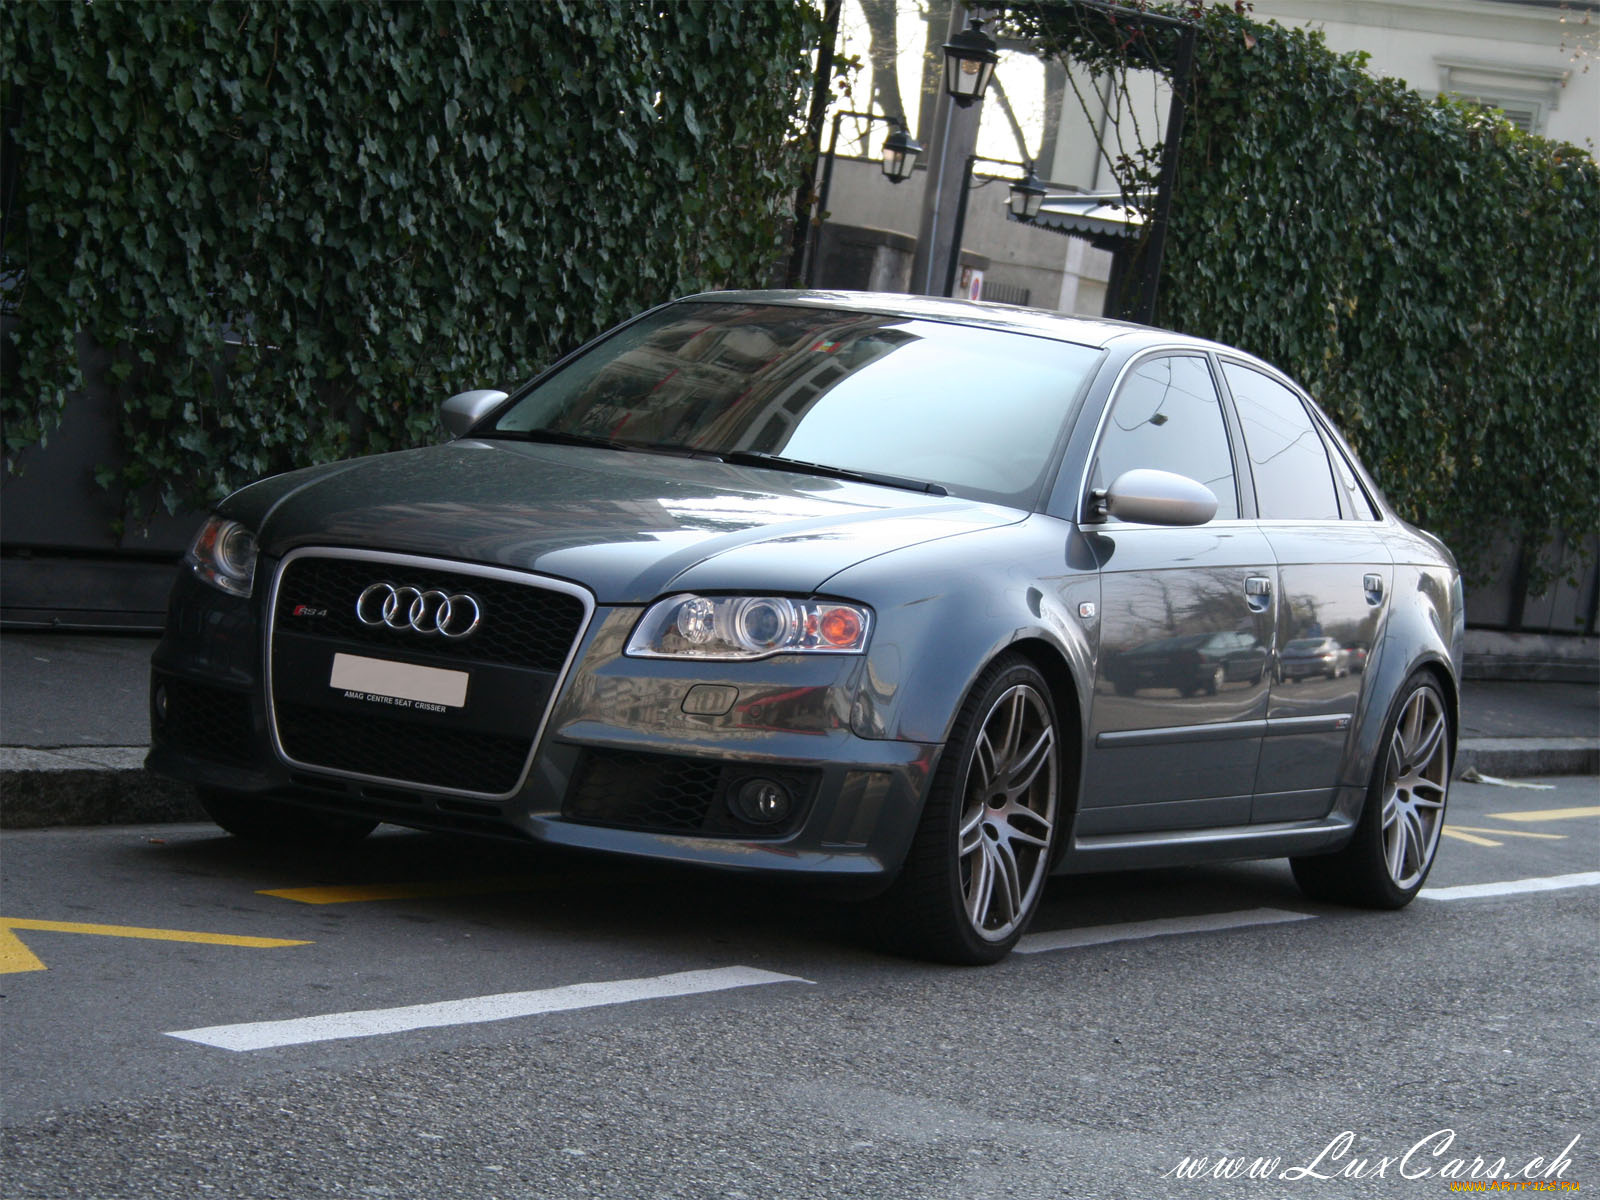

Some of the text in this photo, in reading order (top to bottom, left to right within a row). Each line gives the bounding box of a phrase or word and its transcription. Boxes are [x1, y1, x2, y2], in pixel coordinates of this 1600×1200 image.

[344, 690, 447, 713] AMAG CENTRE SEAT CRISSIER
